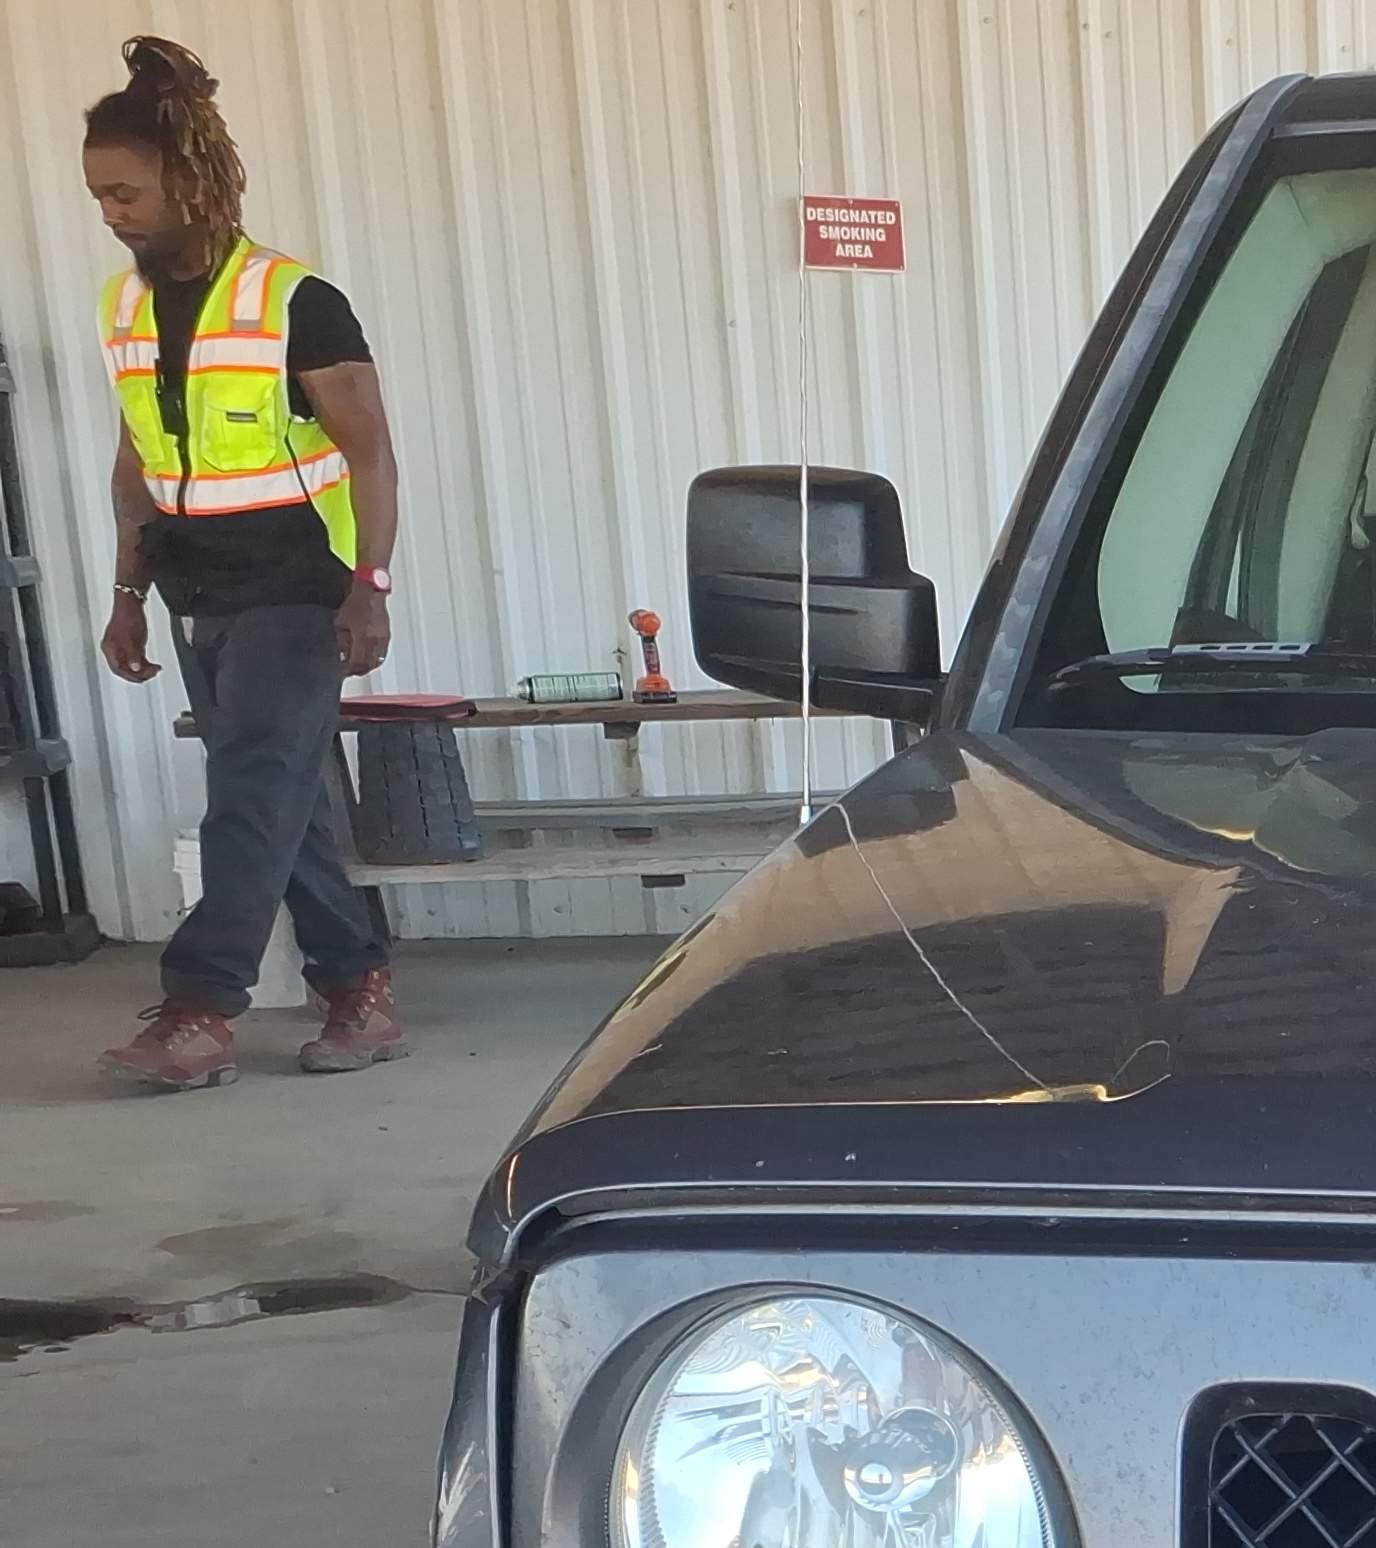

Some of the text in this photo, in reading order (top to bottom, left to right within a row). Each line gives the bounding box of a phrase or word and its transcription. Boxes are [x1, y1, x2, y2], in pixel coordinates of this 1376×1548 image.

[806, 207, 896, 225] DESIGNATED
[819, 225, 887, 242] SMOKING
[835, 243, 873, 258] AREA
